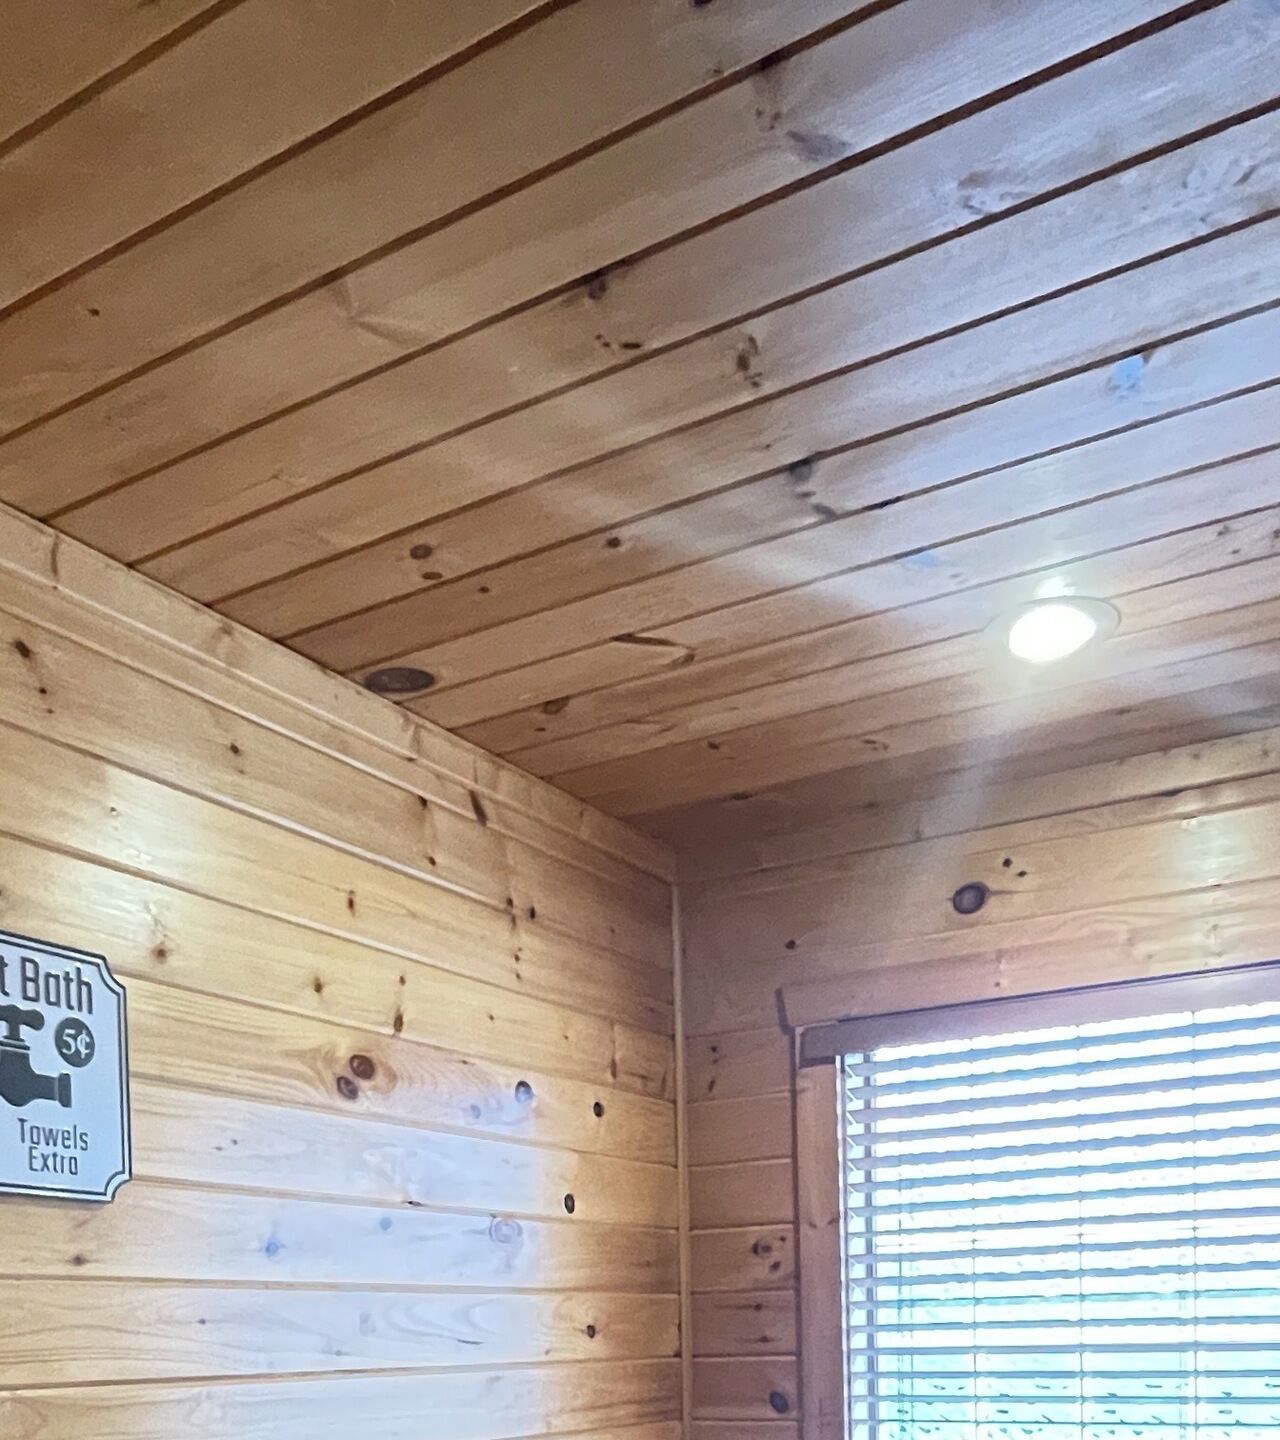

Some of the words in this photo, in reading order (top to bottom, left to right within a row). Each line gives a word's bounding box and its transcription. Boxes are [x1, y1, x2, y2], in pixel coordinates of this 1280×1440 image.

[21, 957, 95, 1014] Bath
[18, 1118, 89, 1151] Towels
[28, 1147, 79, 1176] Extra
